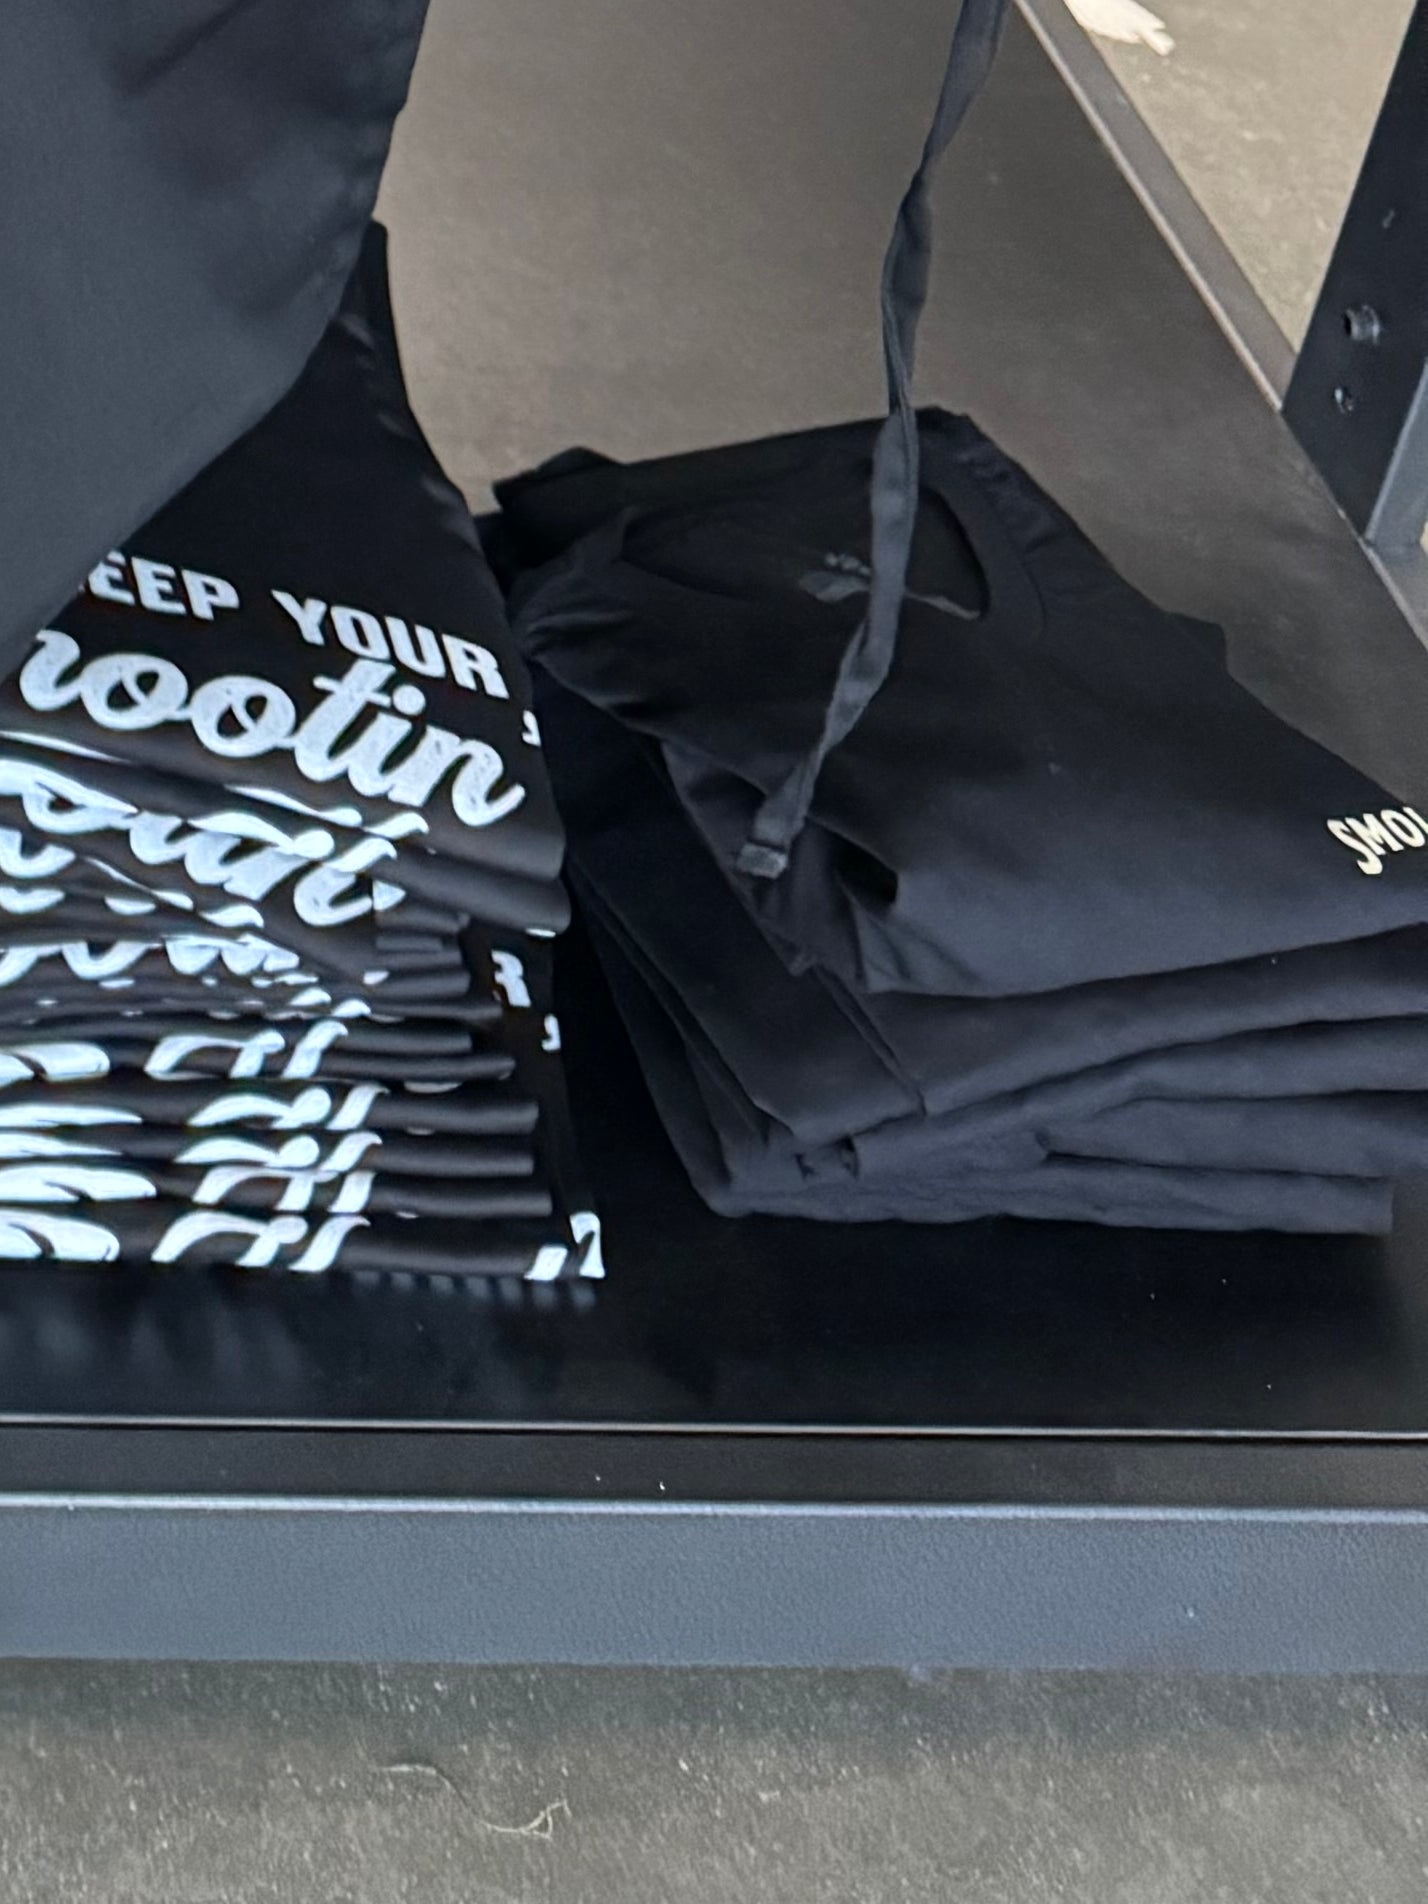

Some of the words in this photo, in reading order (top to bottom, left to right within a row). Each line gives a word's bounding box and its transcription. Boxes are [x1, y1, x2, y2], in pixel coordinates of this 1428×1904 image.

[80, 550, 240, 621] EEP
[270, 588, 510, 700] YOUR
[1326, 806, 1428, 875] SMO
